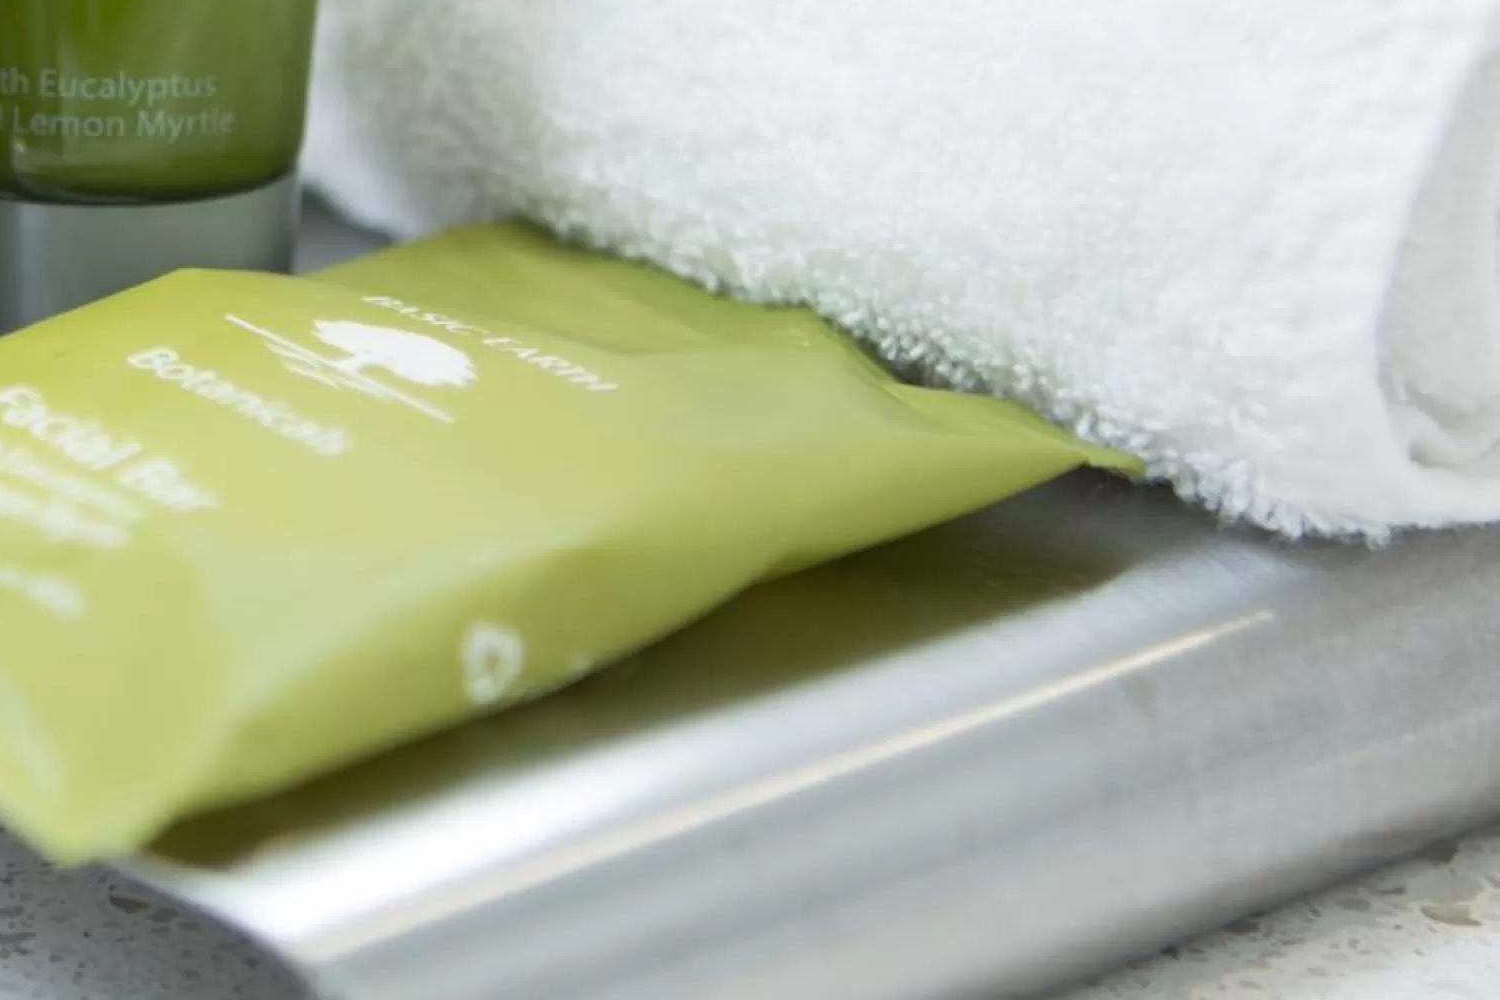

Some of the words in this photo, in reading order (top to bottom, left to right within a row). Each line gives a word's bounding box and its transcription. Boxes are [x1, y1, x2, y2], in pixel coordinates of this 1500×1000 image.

[39, 68, 218, 106] Eucalyptus
[12, 106, 125, 137] Lemon
[136, 106, 236, 144] Myrtle
[480, 336, 620, 392] EARTH
[126, 345, 352, 456] Botanicals
